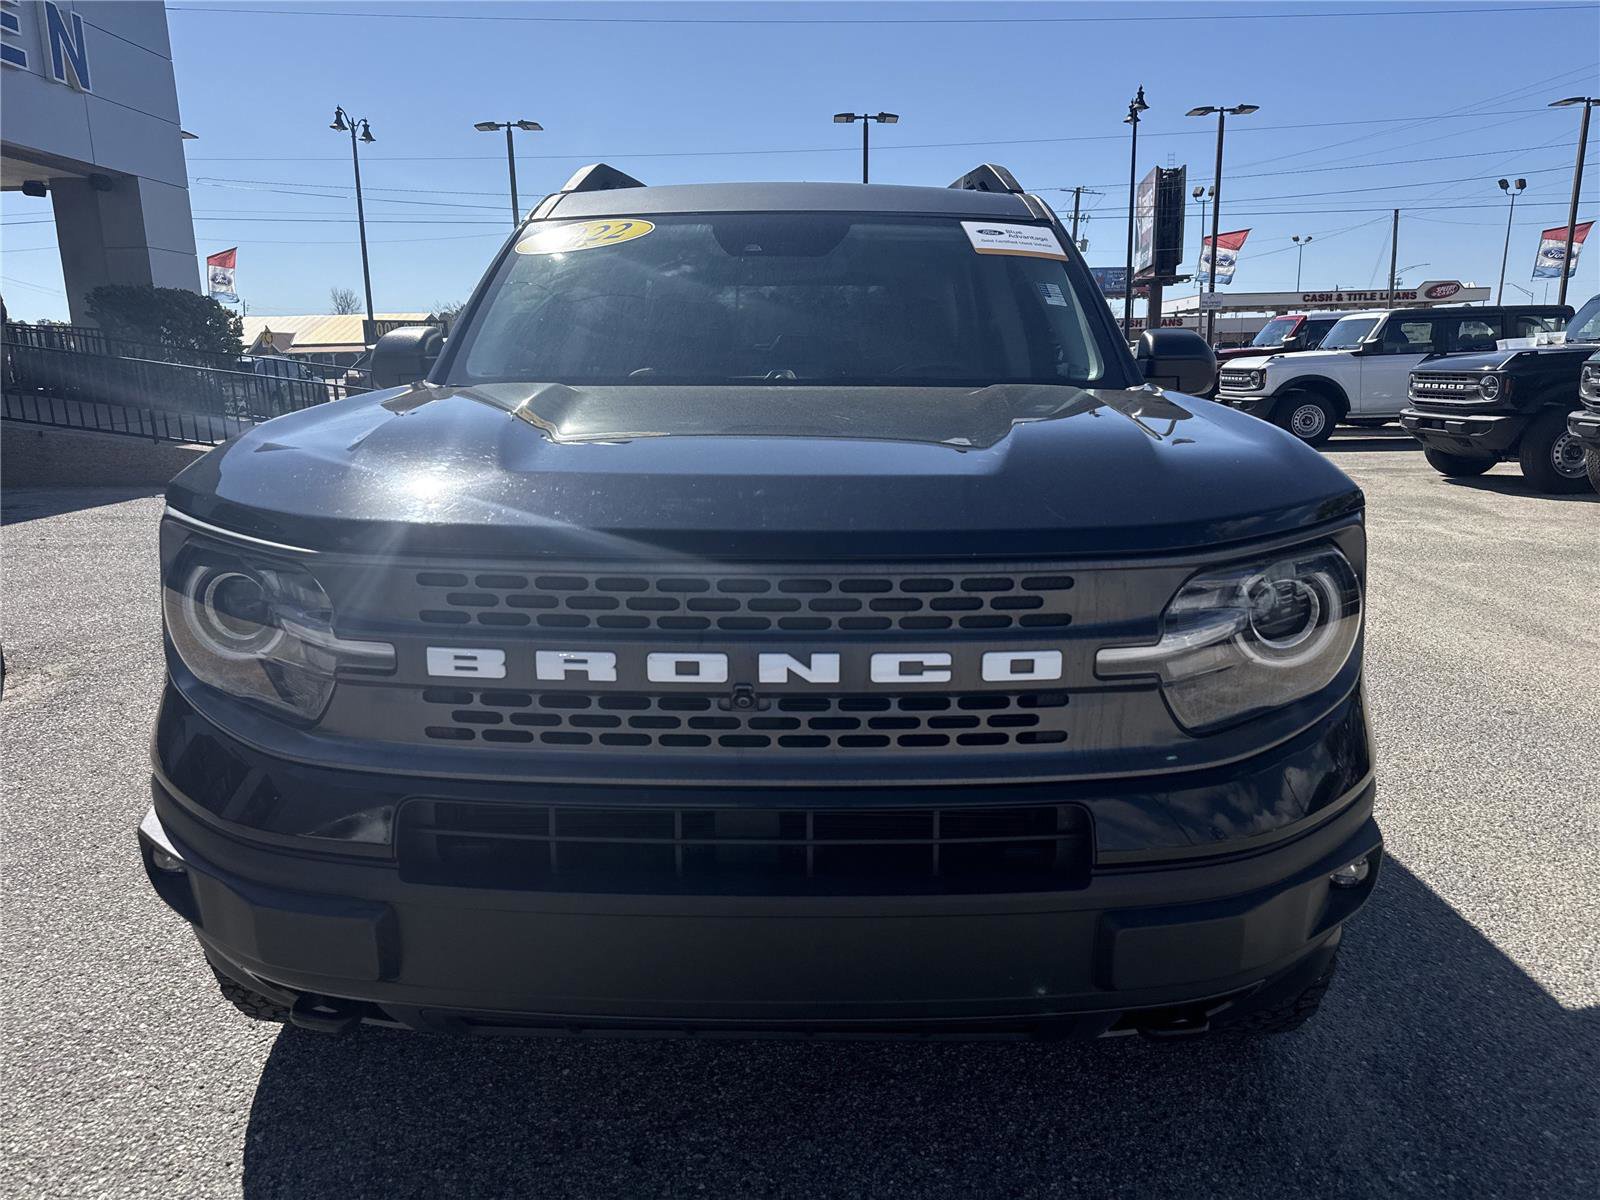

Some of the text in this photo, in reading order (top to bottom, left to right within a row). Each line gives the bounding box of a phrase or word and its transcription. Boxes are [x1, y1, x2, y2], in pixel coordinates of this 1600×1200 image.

[1302, 293, 1333, 302] CASH
[1335, 292, 1344, 301] &
[1345, 292, 1377, 301] TITLE
[427, 646, 1062, 683] BRONCO
